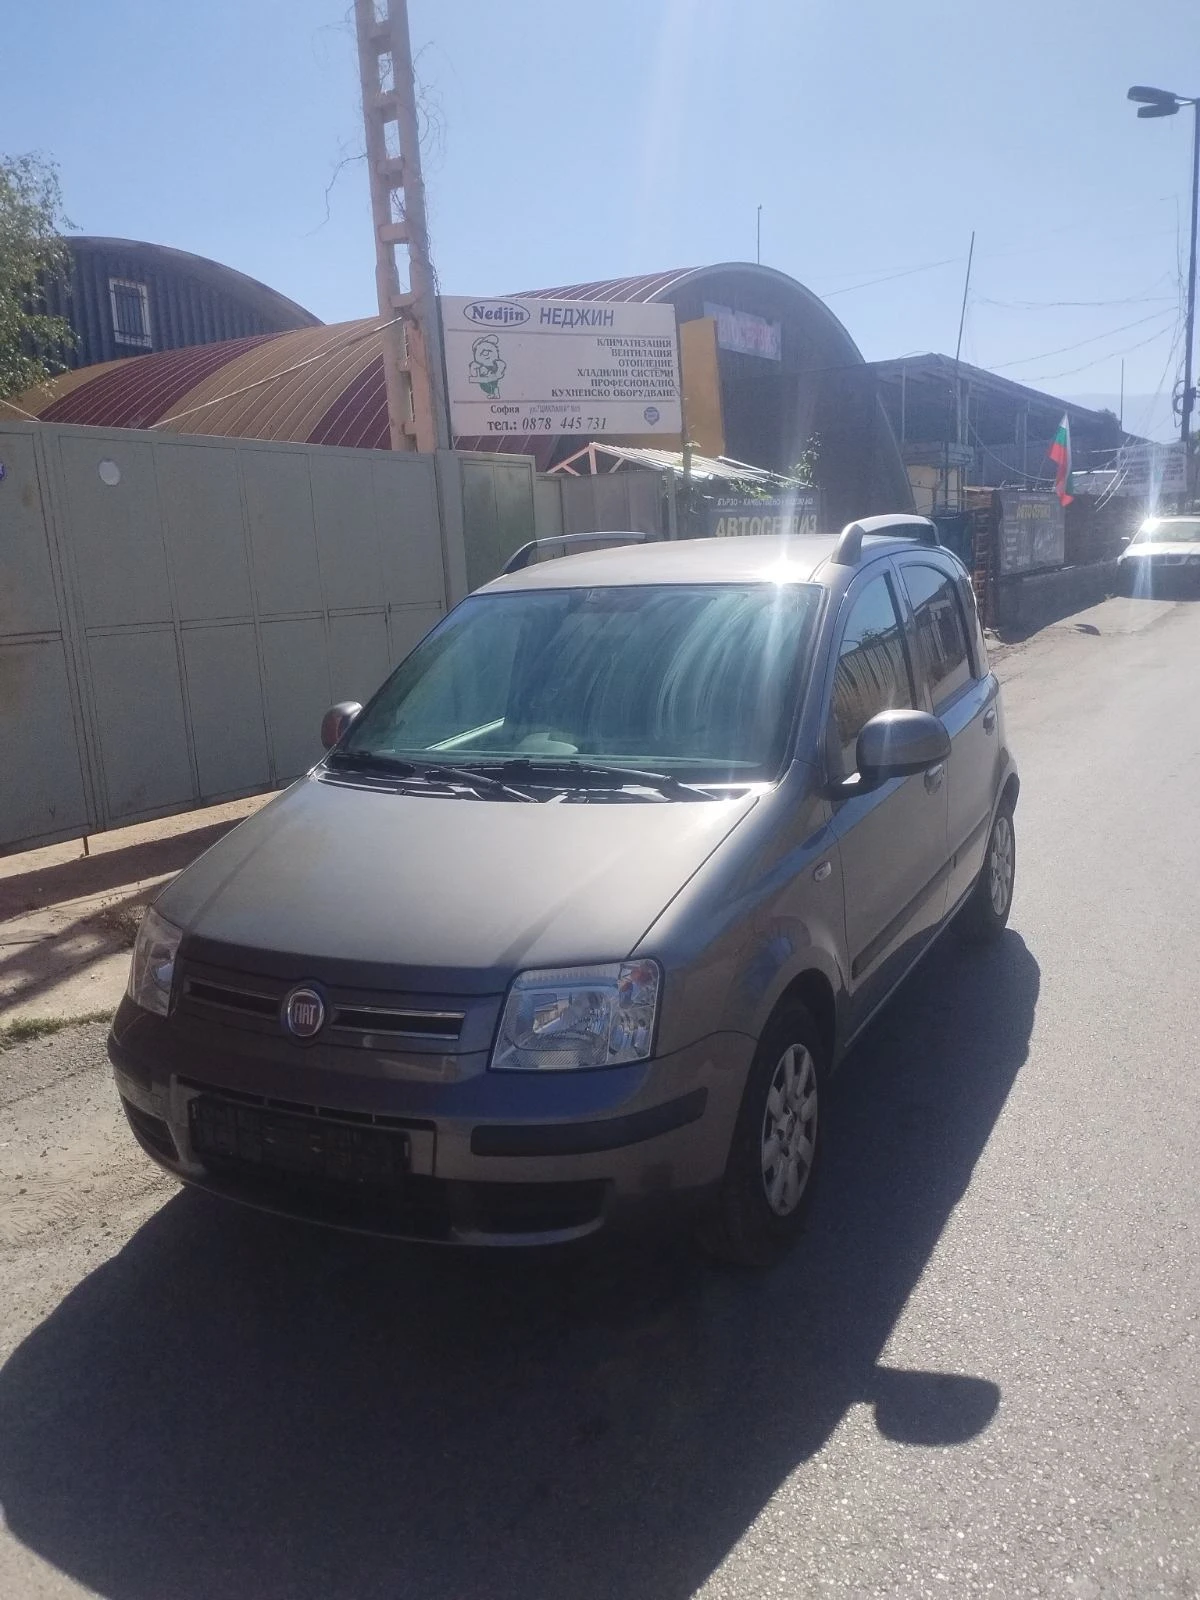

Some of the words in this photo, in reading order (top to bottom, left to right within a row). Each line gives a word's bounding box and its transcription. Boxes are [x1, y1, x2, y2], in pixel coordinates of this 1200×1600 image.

[472, 305, 524, 323] Nedjin
[540, 307, 614, 328] НЕДЖИН
[597, 338, 672, 348] КЛИМАТИЗАЦИЯ
[611, 348, 672, 357] ВЕНТИЛАЦИЯ
[618, 359, 673, 368] ОТОПЛЕНИЕ
[577, 368, 628, 378] ХЛАДИЛНИ
[631, 369, 674, 378] СИСТЕМИ
[591, 379, 675, 388] ПРОФЕСИОНАЛНО
[613, 389, 676, 399] ОБОРУДВАНЕ
[490, 404, 520, 415] София
[487, 420, 517, 431] тел.:
[522, 417, 552, 430] 0878
[560, 417, 583, 430] 445
[587, 417, 607, 430] 731
[294, 1003, 317, 1025] FIAT
